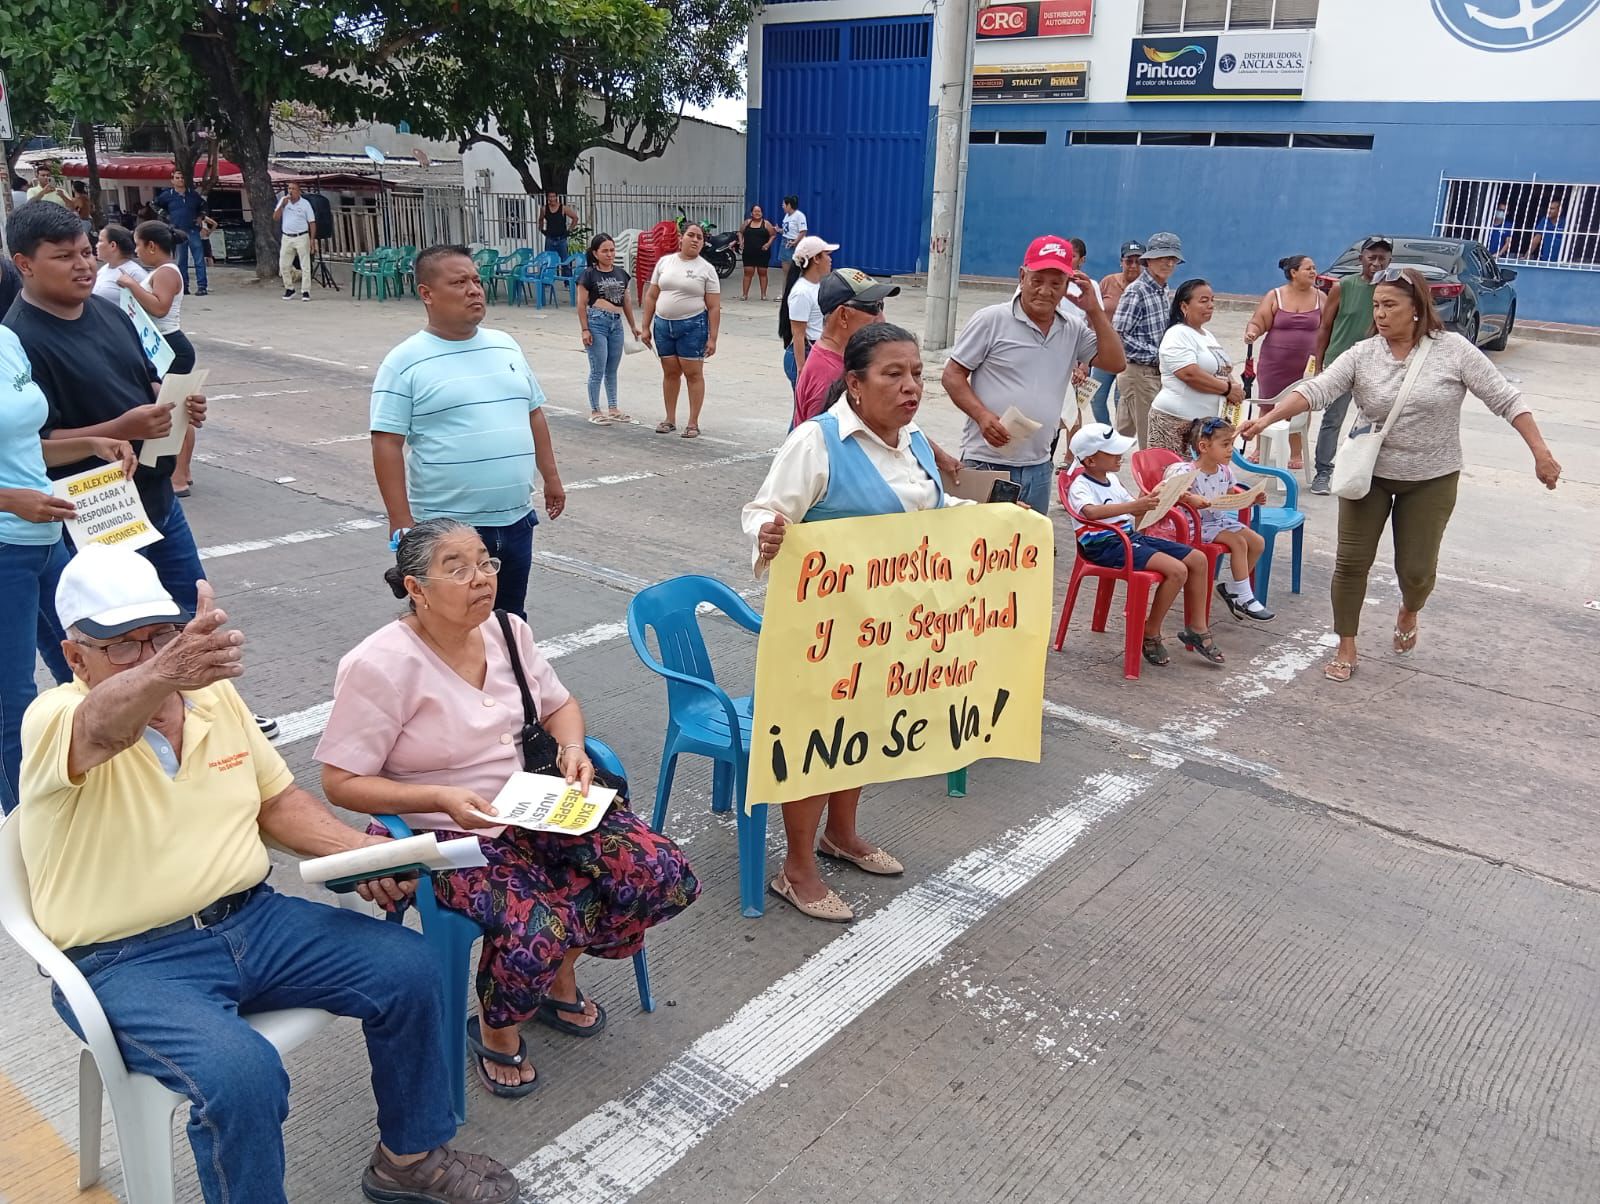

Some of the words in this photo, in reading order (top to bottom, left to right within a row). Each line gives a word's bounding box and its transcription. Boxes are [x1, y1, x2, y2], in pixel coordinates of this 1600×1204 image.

[980, 11, 1024, 30] CRC
[1043, 10, 1087, 19] DISTRIBUIDOR
[1044, 17, 1086, 26] AUTORIZADO
[1239, 59, 1274, 69] ANCLA
[1275, 59, 1305, 69] S.A.S.
[1244, 51, 1302, 60] DISTRIBUIDORA
[1136, 62, 1198, 78] Pintuco
[1011, 78, 1043, 87] STANLEY
[68, 485, 82, 496] SR.
[81, 478, 101, 491] ALEX
[103, 470, 125, 484] CHAR
[76, 499, 89, 510] DE
[89, 494, 100, 506] LA
[99, 488, 120, 501] CARA
[120, 485, 127, 494] Y
[77, 502, 119, 525] RESPONDA
[118, 501, 125, 510] A
[126, 496, 136, 508] LA
[87, 511, 137, 536] COMUNIDAD.
[103, 528, 138, 546] UCIONES
[136, 522, 150, 534] YA
[796, 550, 854, 603] Por
[866, 535, 953, 591] nuestra
[966, 532, 1039, 586] gente
[806, 618, 835, 663] y
[857, 616, 892, 649] su
[831, 662, 863, 701] el
